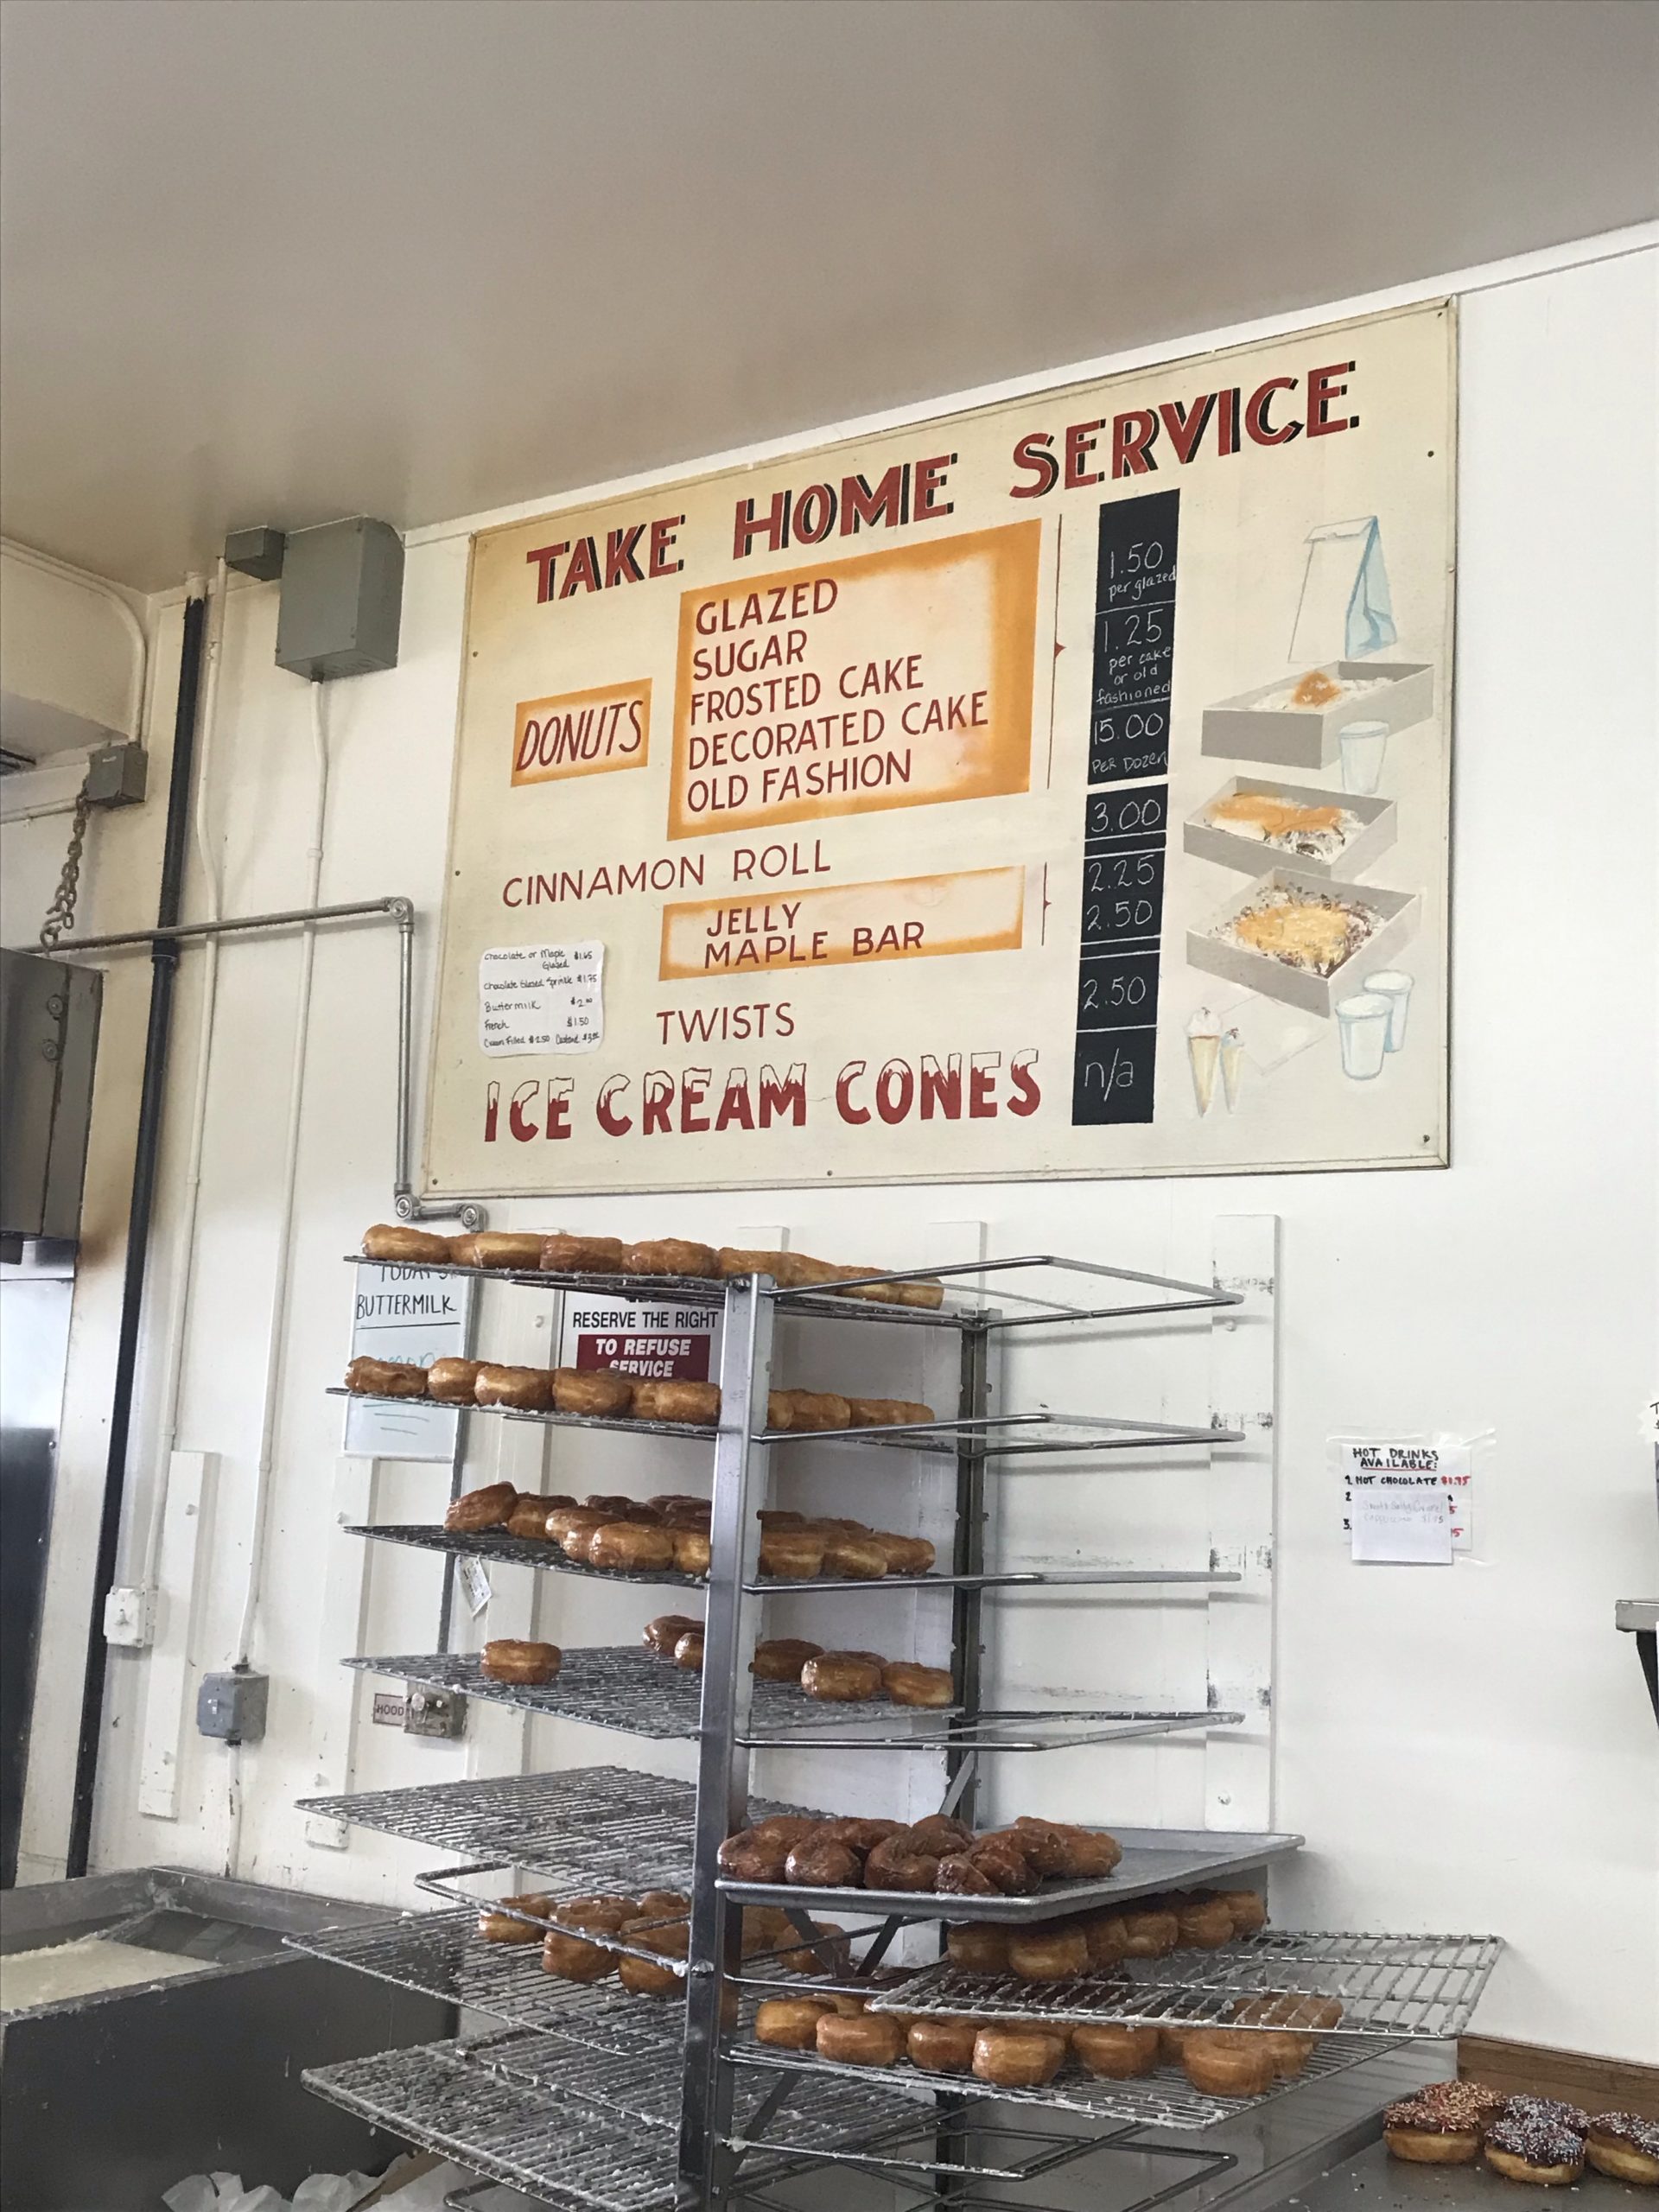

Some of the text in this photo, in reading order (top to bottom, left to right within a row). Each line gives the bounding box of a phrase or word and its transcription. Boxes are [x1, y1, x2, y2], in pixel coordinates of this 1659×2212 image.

[526, 360, 1360, 604] TAKE HOME SERVICE
[1110, 541, 1163, 579] 1.50
[1109, 564, 1176, 602] per glazed
[695, 578, 838, 636] GLAZED
[1104, 608, 1163, 652] 1.25
[693, 629, 808, 681] SUGAR
[1109, 646, 1172, 675] per cake
[691, 654, 924, 726] FROSTED CAKE
[1096, 679, 1172, 705] fashioned
[1114, 664, 1158, 685] or old
[516, 699, 644, 772] DONUTS
[689, 690, 988, 770] DECORATED CAKE
[1094, 713, 1163, 745] 15.00
[688, 748, 912, 813] OLD FASHION
[1090, 798, 1161, 833] 3.00
[502, 839, 831, 908] CINNAMON ROLL
[1089, 854, 1154, 892] 2.25
[706, 901, 802, 938] JELLY
[1086, 899, 1153, 931] 2.50
[703, 921, 925, 969] MAPLE BAR
[1083, 976, 1146, 1010] 2.50
[656, 1001, 795, 1045] TWISTS
[1084, 1048, 1134, 1102] n/a
[484, 1046, 1041, 1143] ICE CREAM CONES
[356, 1294, 457, 1320] BUTTERMILK
[572, 1311, 719, 1328] RESERVE THE RIGHT
[595, 1338, 692, 1356] TO REFUSE
[609, 1360, 675, 1377] SERVICE
[1352, 1447, 1440, 1461] HOT DRINKS
[1355, 1475, 1377, 1485] HOT
[1380, 1476, 1438, 1486] CHOCOLATE
[376, 1704, 404, 1717] HOOD
